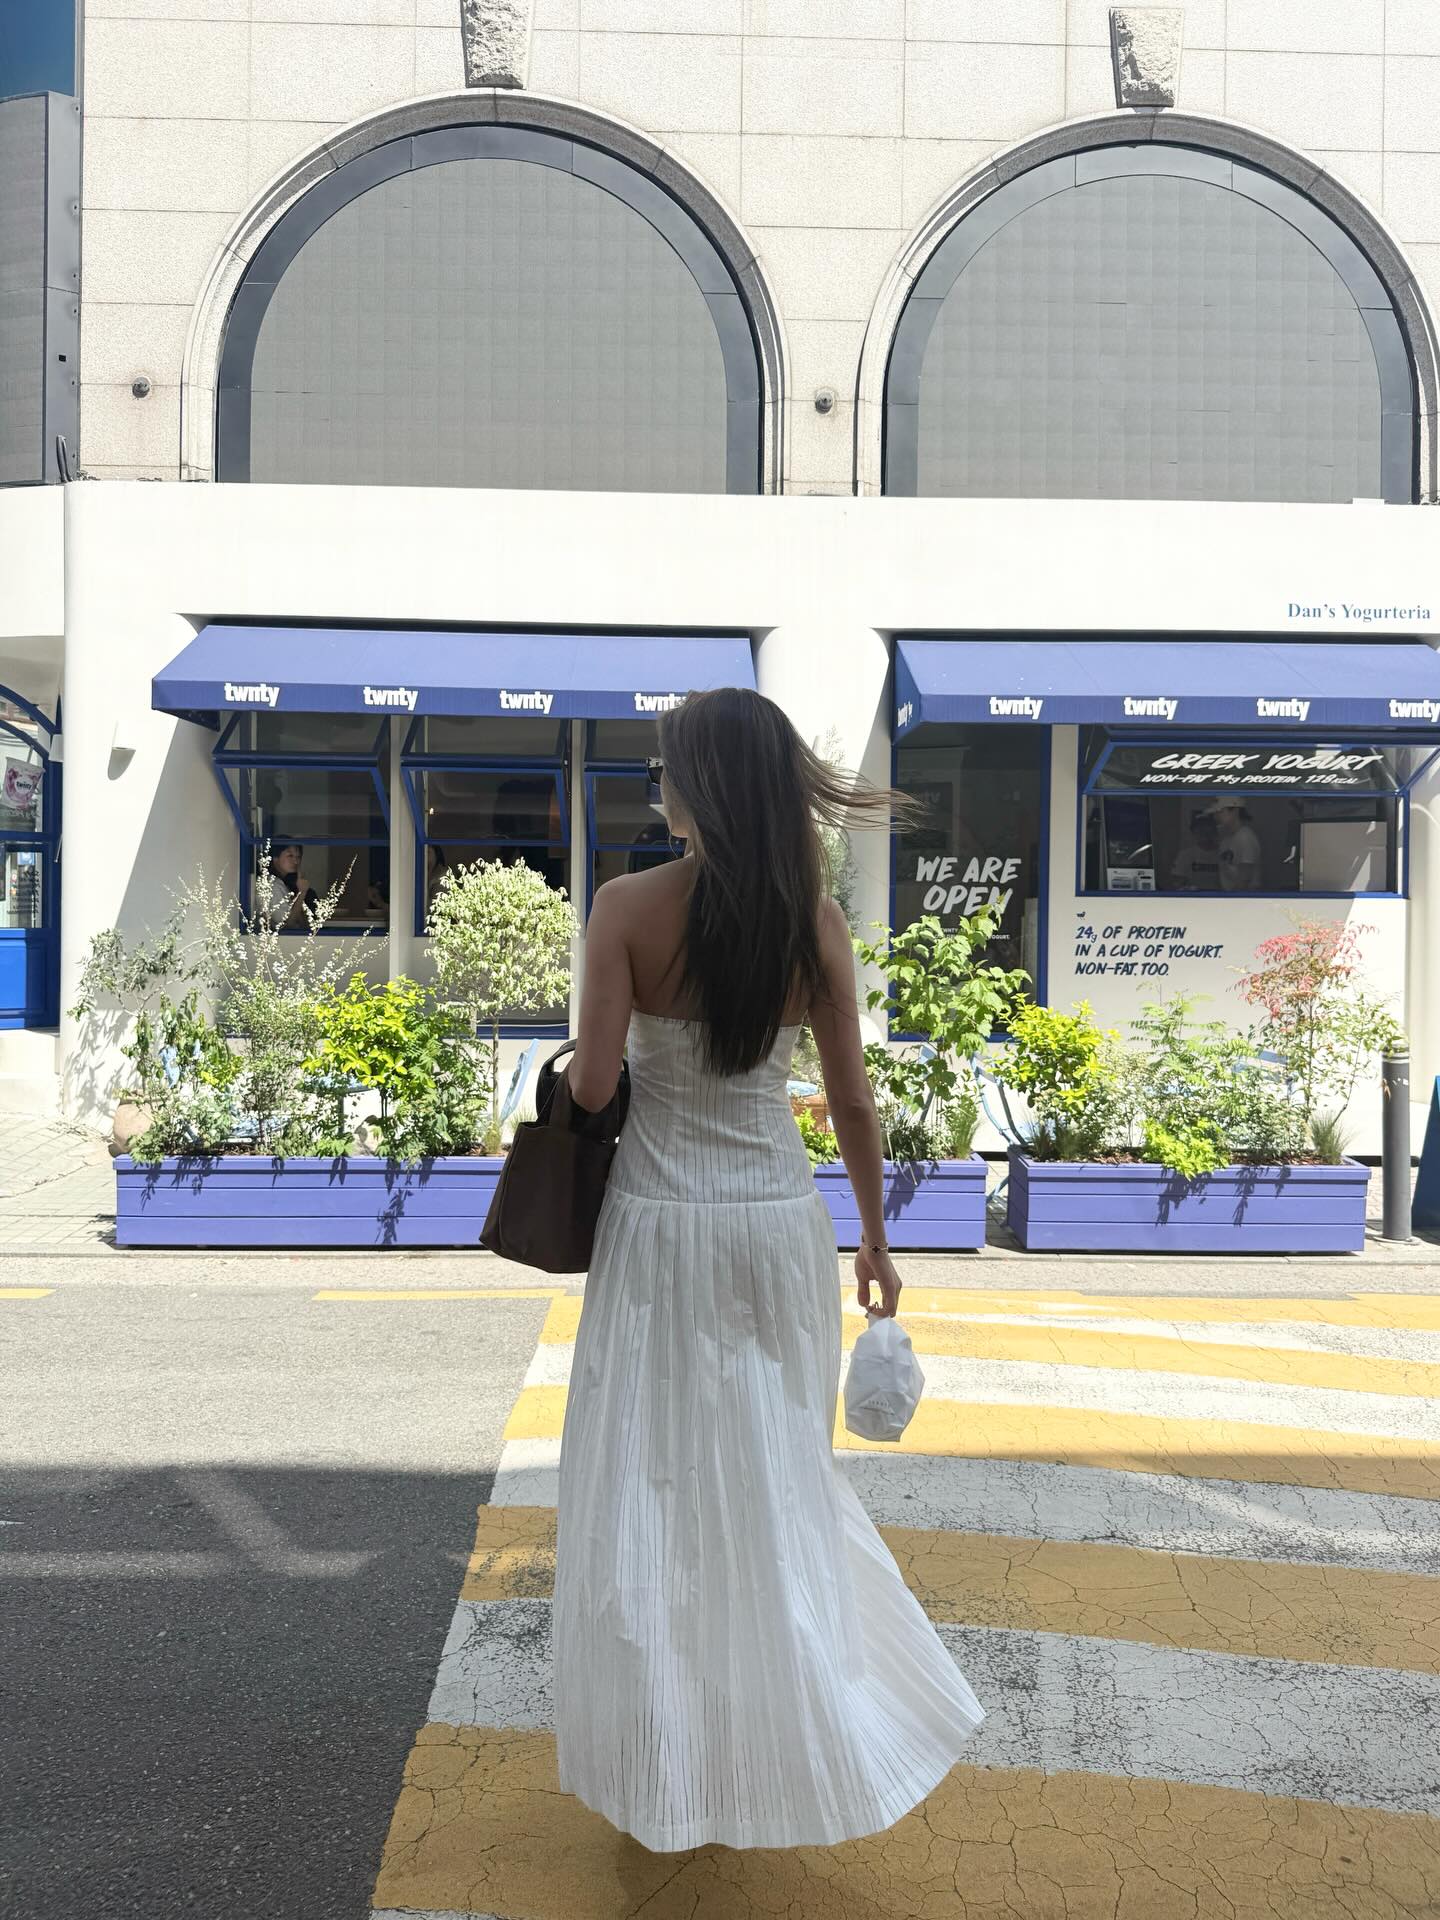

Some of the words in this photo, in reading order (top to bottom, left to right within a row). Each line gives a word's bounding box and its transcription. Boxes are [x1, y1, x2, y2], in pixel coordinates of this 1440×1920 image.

[1288, 603, 1336, 618] Dan's
[1341, 603, 1431, 623] Yogurteria
[224, 682, 279, 707] twnty
[363, 686, 418, 711] twnty
[500, 690, 553, 714] twnty
[989, 696, 1043, 720] twnty
[1123, 697, 1178, 720] twnty
[1256, 698, 1310, 722] twnty
[1389, 699, 1440, 722] twnty
[1151, 753, 1260, 770] GREEK
[1262, 753, 1384, 770] YOGURT
[1140, 773, 1212, 784] NON-FAT
[1241, 774, 1302, 784] PROTEIN
[915, 855, 958, 882] WE
[962, 856, 1022, 884] ARE
[922, 884, 1013, 916] OPEN
[1075, 926, 1098, 943] 24g
[1102, 925, 1123, 939] OF
[1127, 926, 1187, 940] PROTEIN
[1075, 944, 1092, 956] IN
[1096, 943, 1106, 957] A
[1109, 944, 1139, 957] CUP
[1143, 944, 1164, 958] OF
[1168, 944, 1223, 959] YOGURT.
